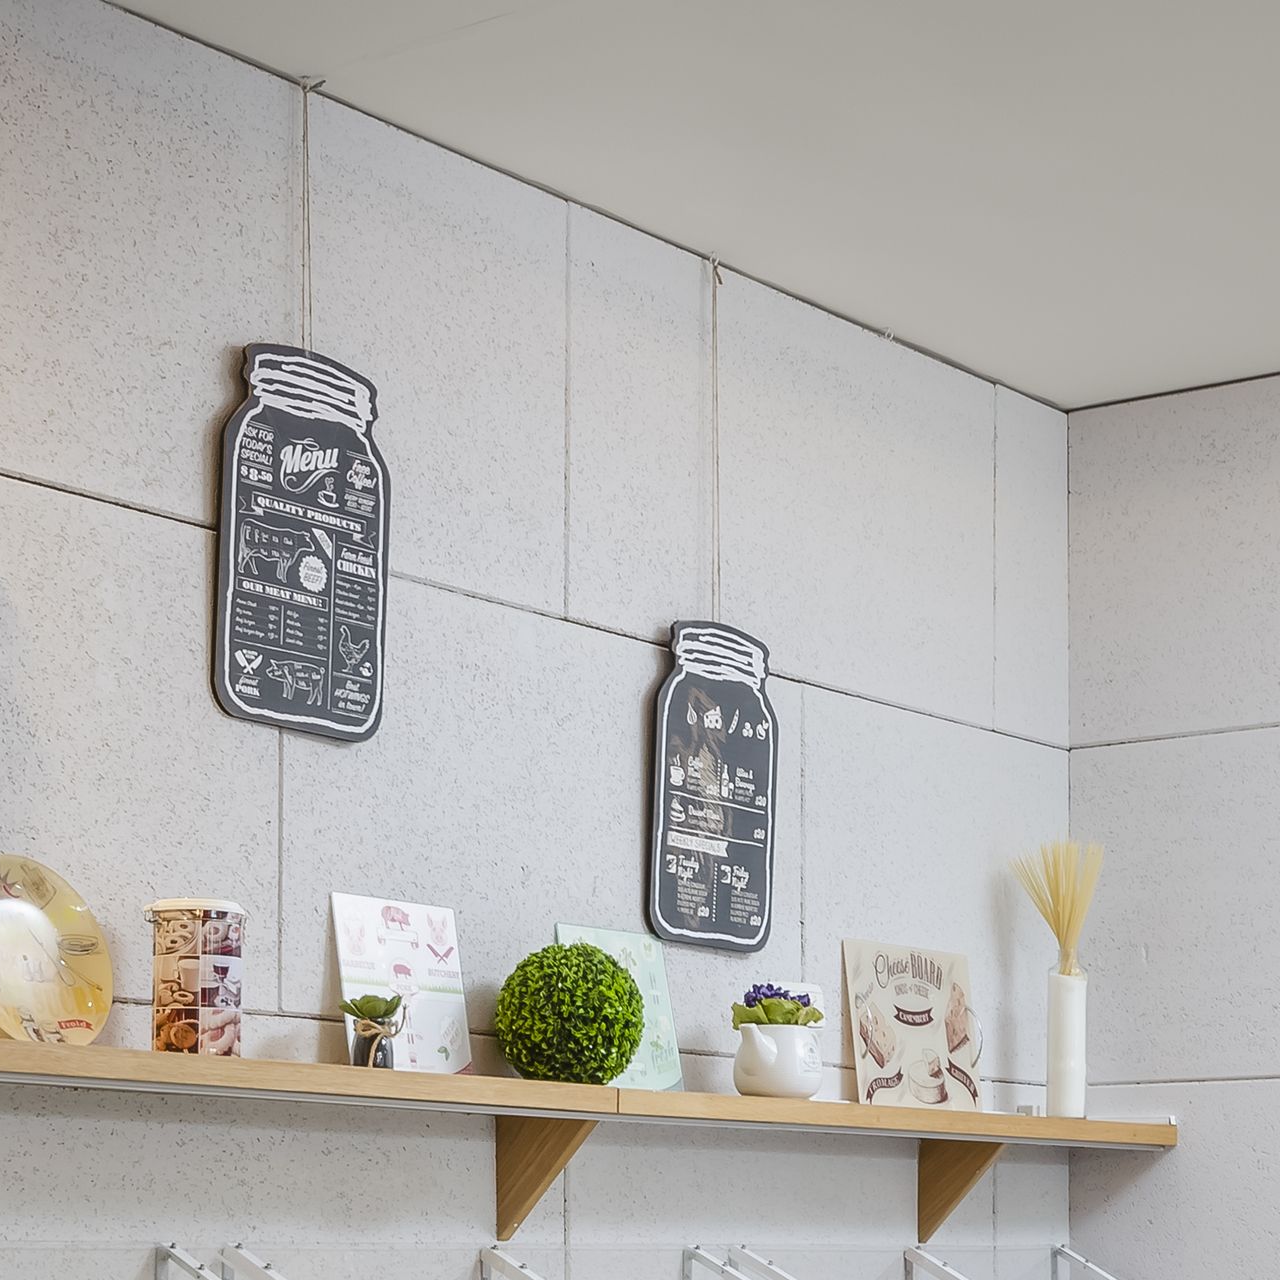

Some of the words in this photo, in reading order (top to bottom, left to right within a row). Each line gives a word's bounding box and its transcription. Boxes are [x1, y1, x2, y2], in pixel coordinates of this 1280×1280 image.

[241, 437, 273, 455] TODAY'S
[259, 429, 274, 443] FOR
[240, 448, 273, 466] SPECIAL!
[280, 440, 339, 482] Menu
[256, 495, 307, 518] QUALITY
[307, 508, 362, 532] PRODUCTS
[337, 559, 376, 579] CHICKEN
[242, 580, 264, 593] OUR
[264, 585, 292, 600] MEAT
[235, 684, 261, 697] PORK
[872, 954, 911, 989] Cheese
[910, 952, 944, 991] BOARD
